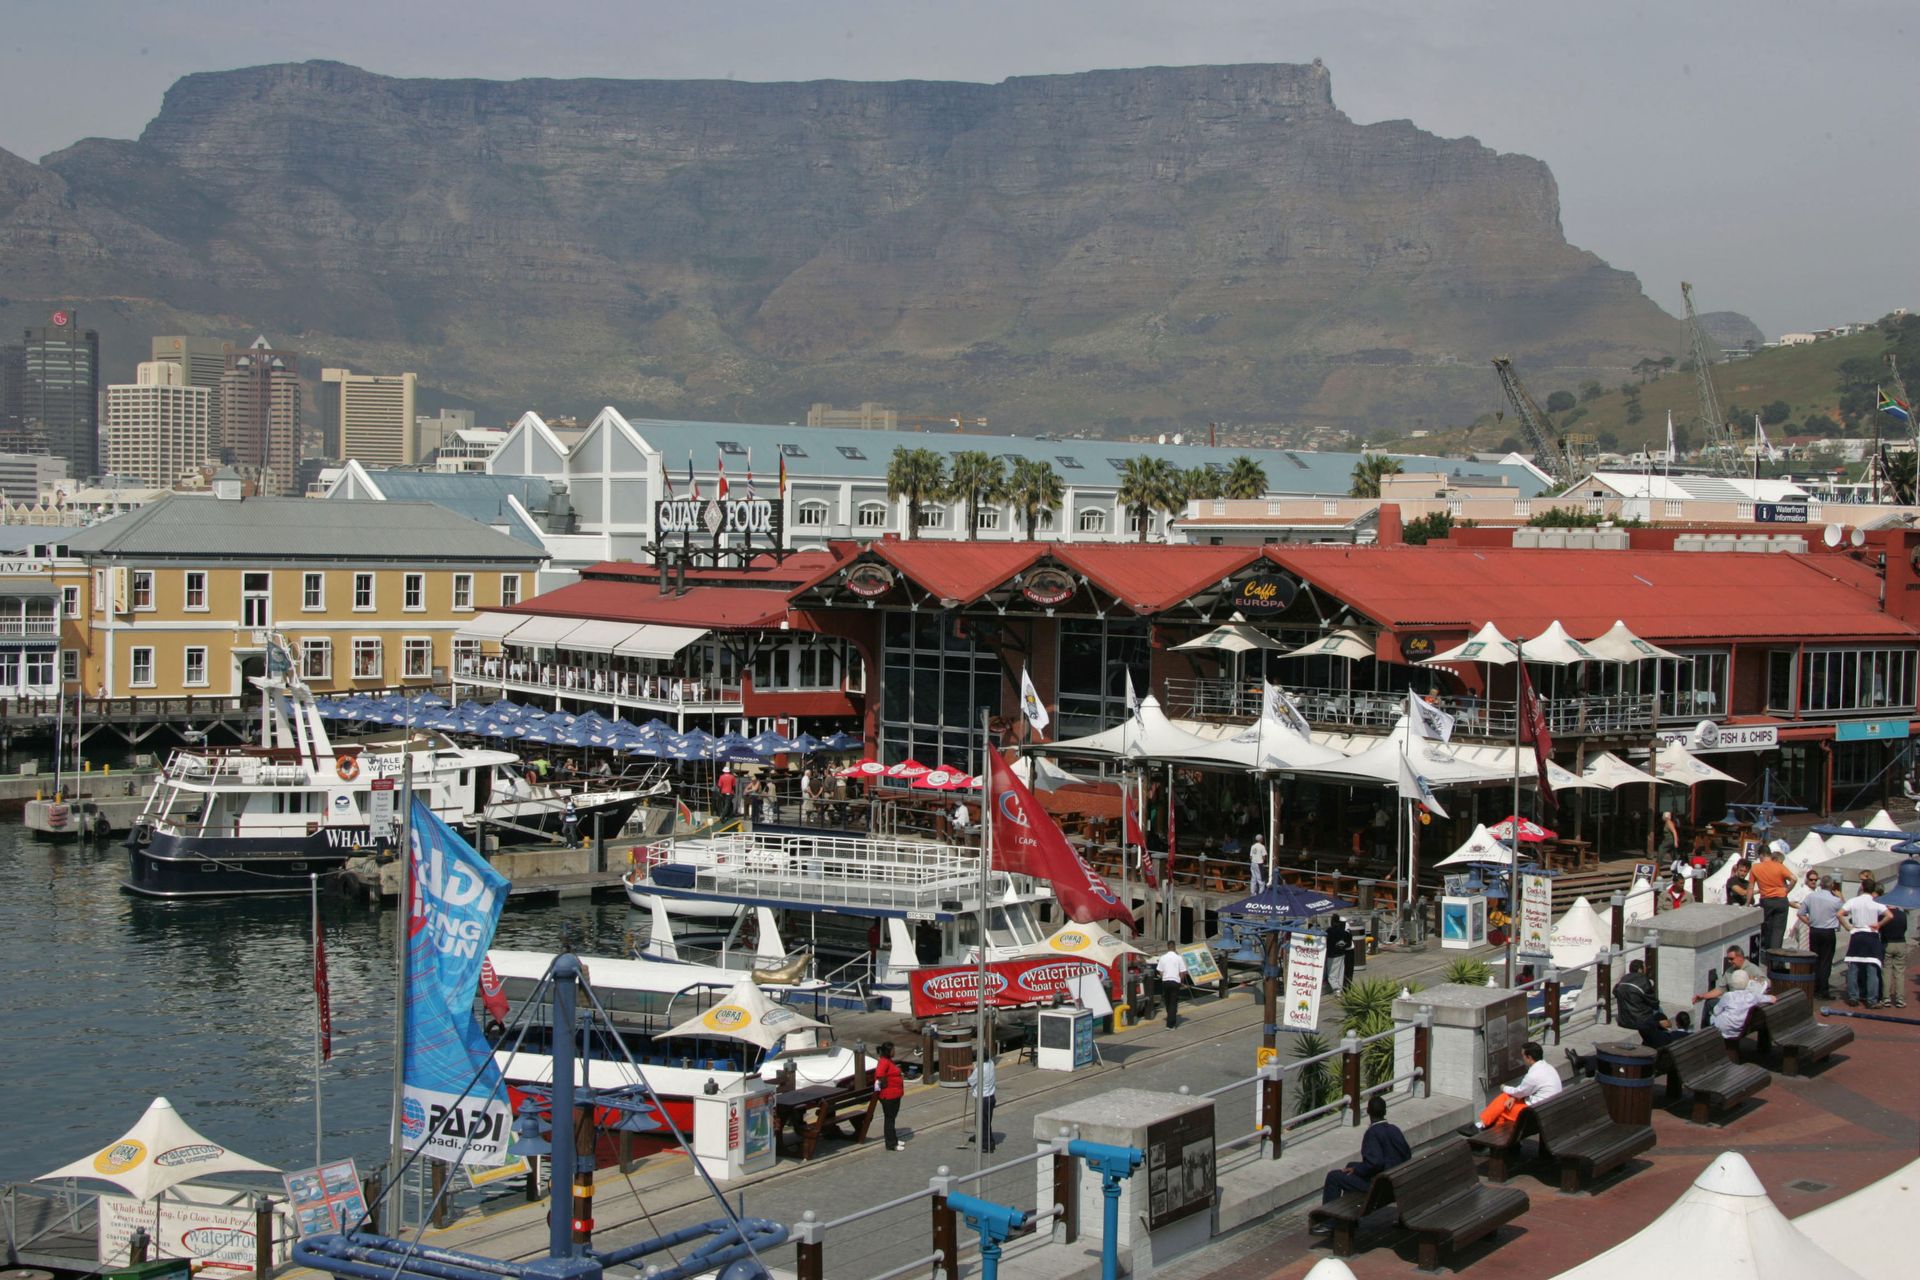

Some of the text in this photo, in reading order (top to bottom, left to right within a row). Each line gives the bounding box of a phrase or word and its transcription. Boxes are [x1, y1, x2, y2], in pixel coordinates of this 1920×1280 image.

[1775, 505, 1805, 513] Waterfront
[660, 501, 700, 532] QUAY
[725, 500, 773, 532] FOUR
[1775, 513, 1806, 521] Information
[1235, 598, 1285, 608] EUROPA
[1720, 732, 1738, 744] FISH
[1741, 732, 1746, 743] &
[1749, 730, 1773, 743] CHIPS
[367, 764, 401, 772] WATCH
[1031, 982, 1052, 992] boat
[934, 989, 953, 999] boat
[429, 1103, 504, 1142] PADI
[427, 1135, 498, 1154] padi.com
[112, 1202, 136, 1214] Whale
[177, 1211, 188, 1221] Up
[189, 1211, 210, 1224] Close
[211, 1214, 228, 1225] And
